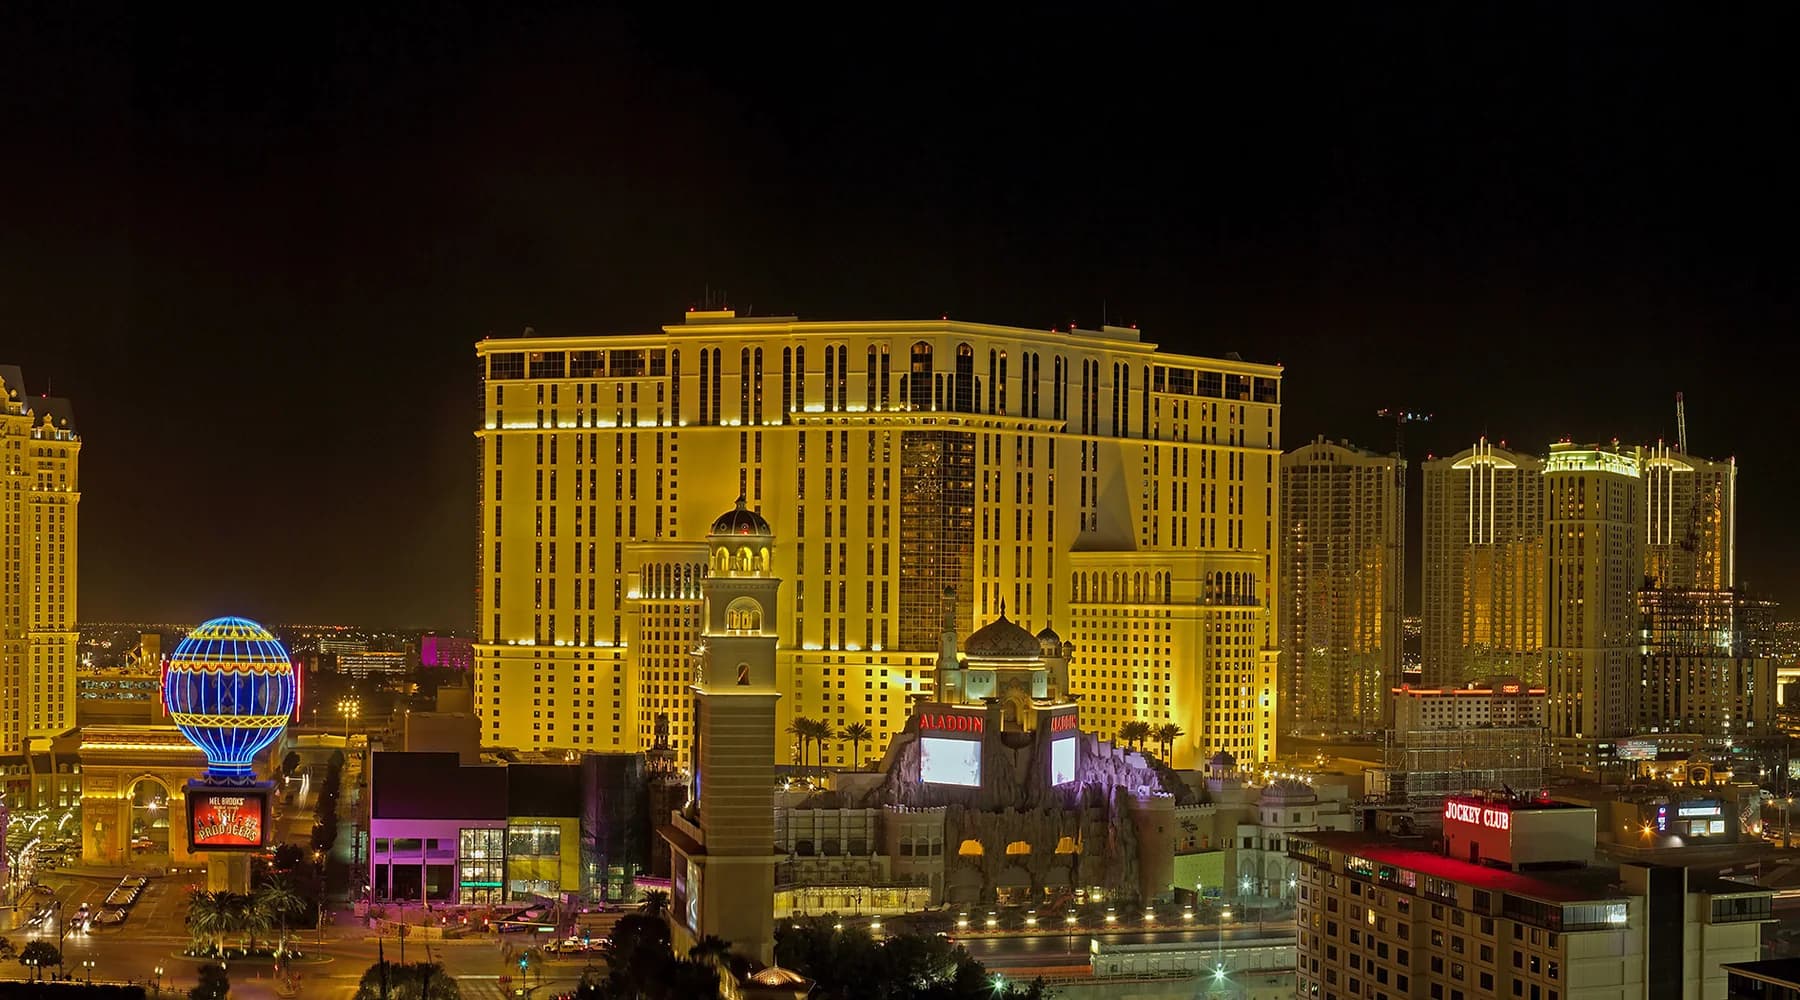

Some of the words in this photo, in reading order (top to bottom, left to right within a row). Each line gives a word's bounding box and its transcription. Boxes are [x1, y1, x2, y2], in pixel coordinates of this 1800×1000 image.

[919, 713, 984, 734] ALADDIN
[1050, 714, 1077, 733] ALADDIN
[208, 797, 221, 805] MEL
[1445, 802, 1481, 824] JOCKEY
[1483, 809, 1509, 830] CLUB
